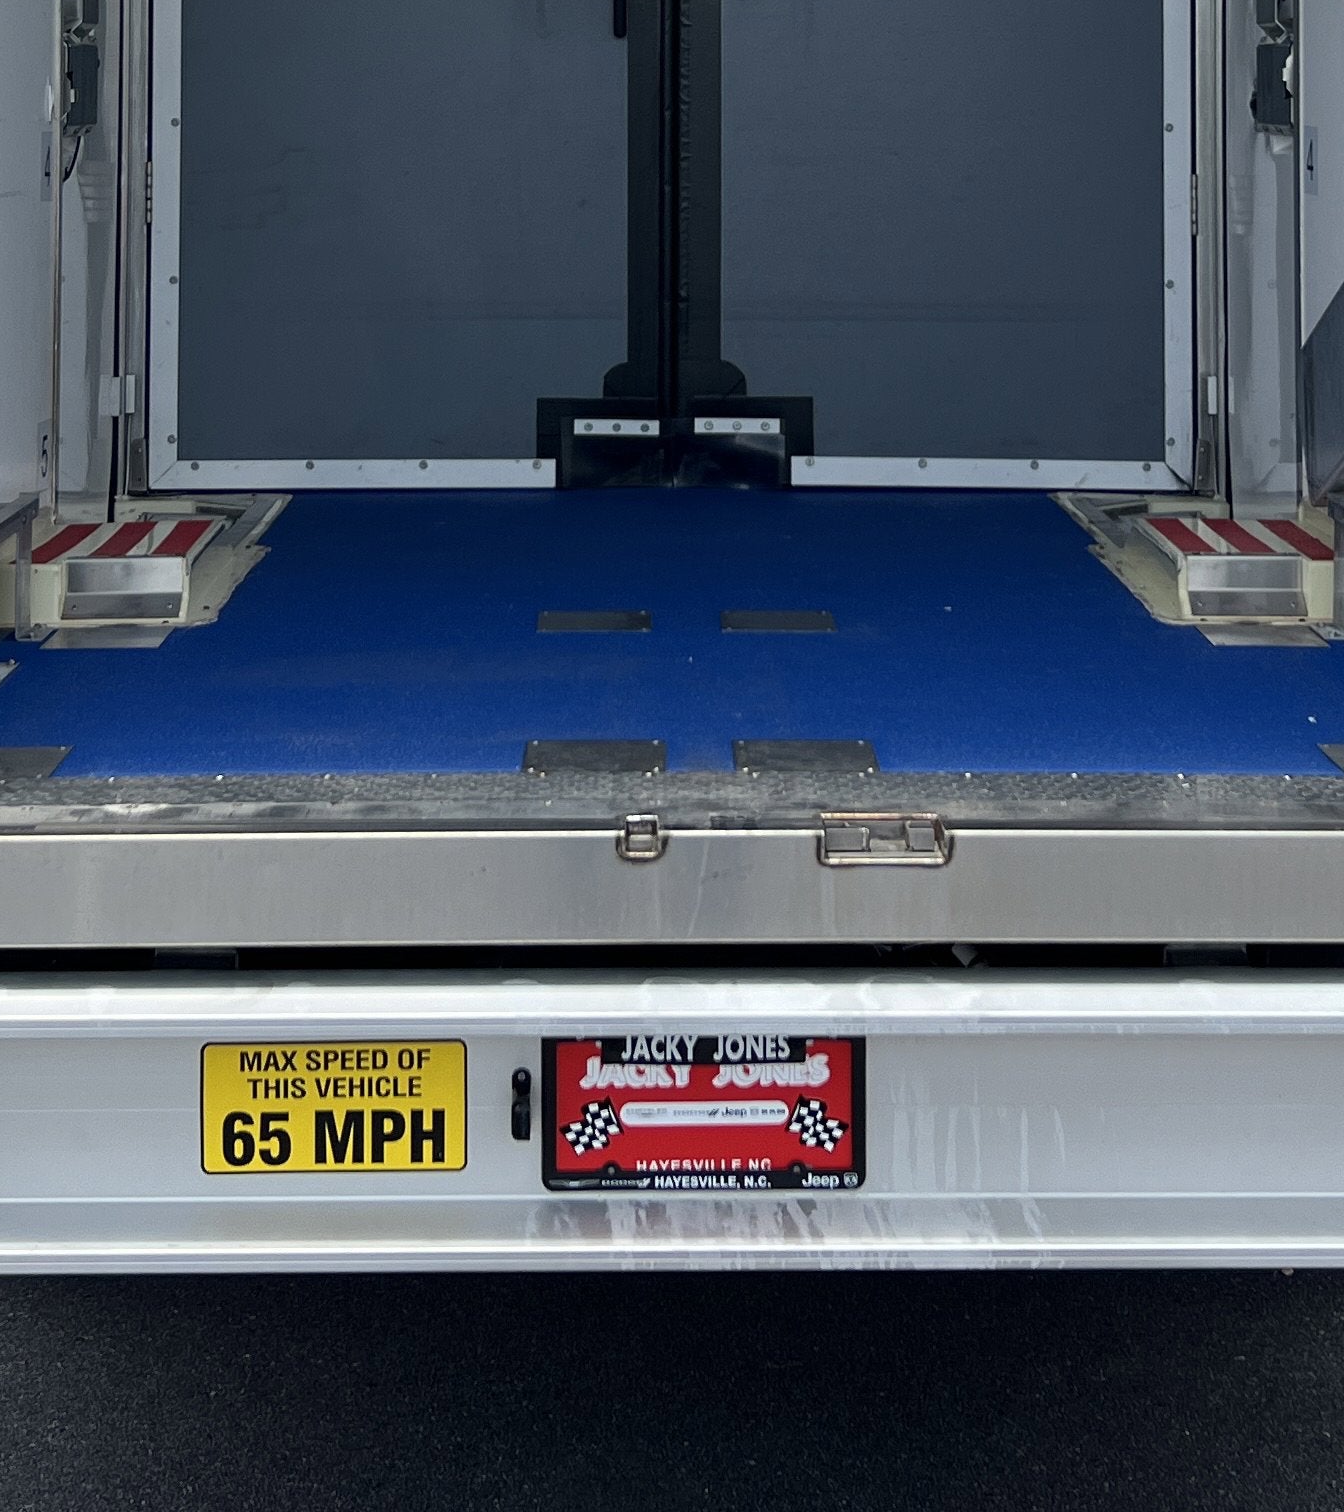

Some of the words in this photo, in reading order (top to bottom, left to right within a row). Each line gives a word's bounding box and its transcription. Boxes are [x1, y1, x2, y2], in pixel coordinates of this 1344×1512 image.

[44, 145, 51, 187] 4
[1306, 138, 1314, 181] 4
[40, 434, 48, 478] 5
[239, 1050, 298, 1072] MAX
[306, 1049, 389, 1072] SPEED
[397, 1048, 431, 1070] OF
[621, 1035, 698, 1062] JACKY
[713, 1034, 790, 1062] JONES
[247, 1077, 307, 1099] THIS
[315, 1076, 422, 1098] VEHICLE
[579, 1056, 692, 1089] JACKY
[712, 1053, 831, 1088] JONES
[221, 1111, 292, 1167] 65
[314, 1108, 446, 1164] MPH
[802, 1172, 840, 1189] Jeep
